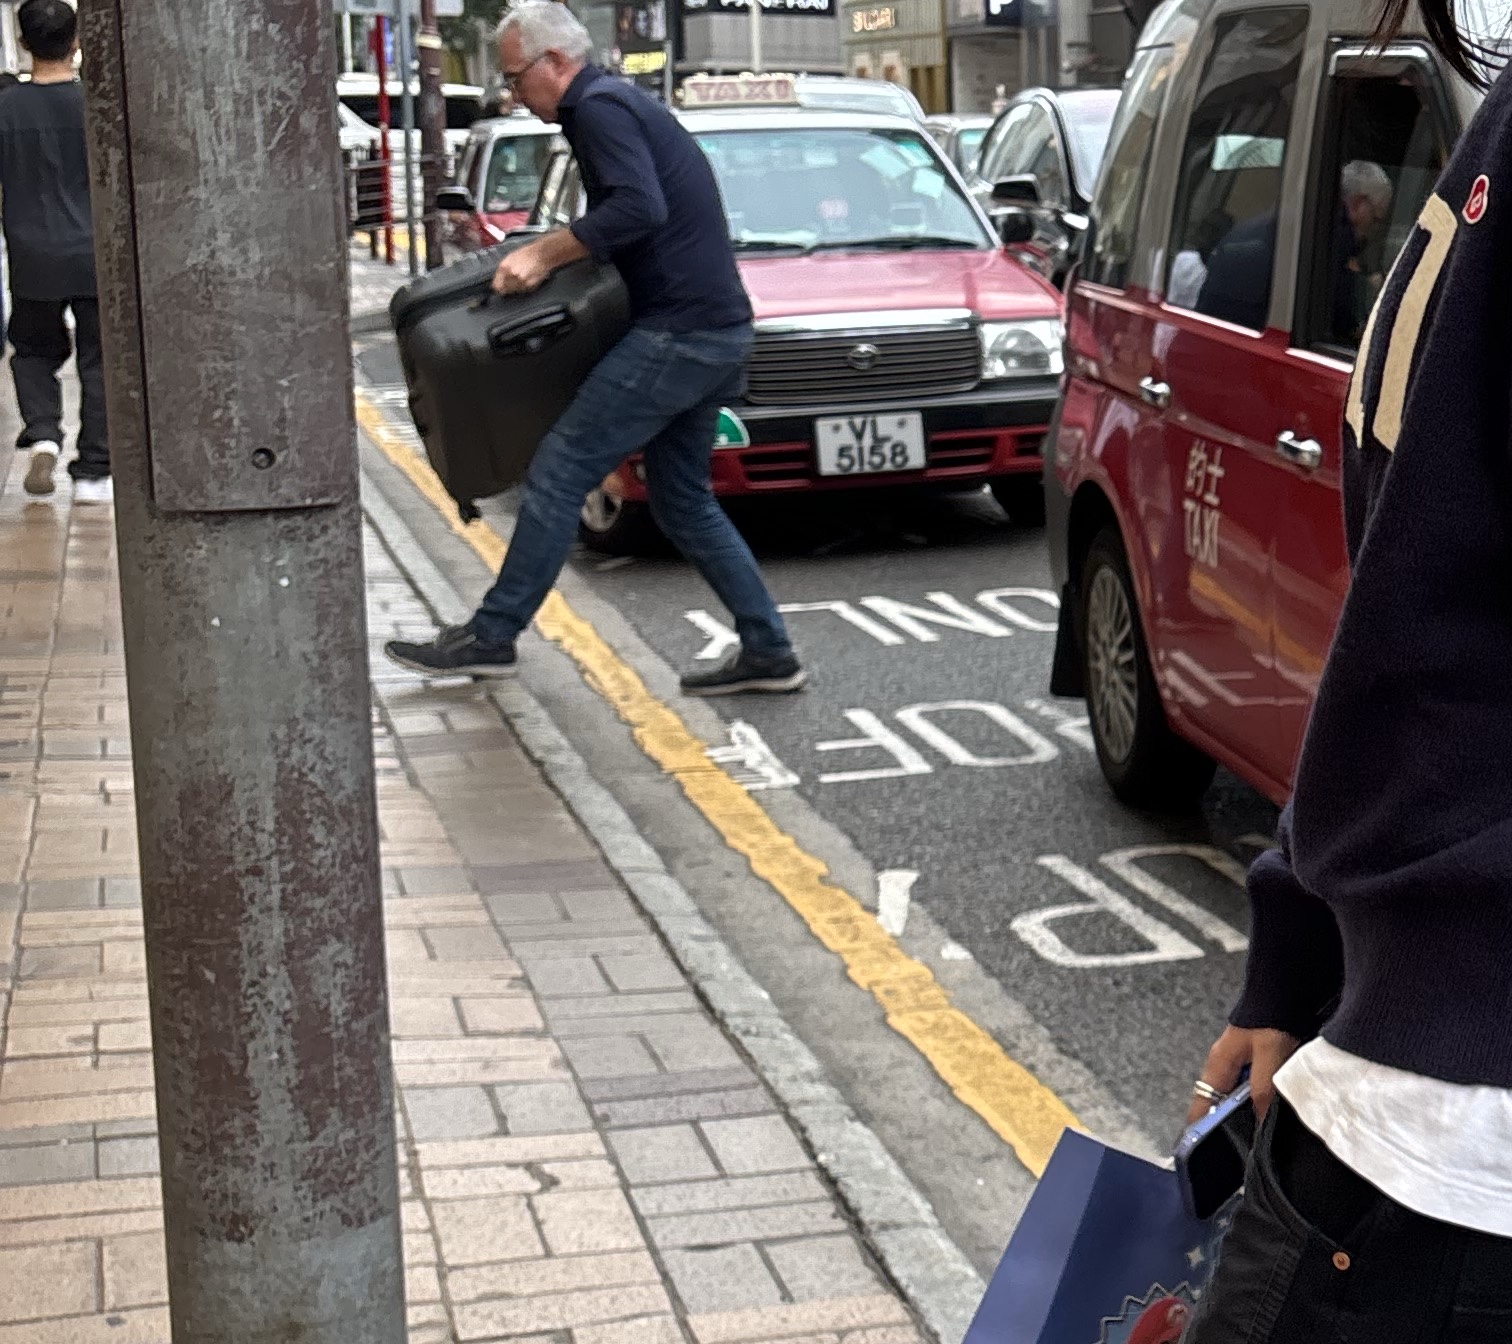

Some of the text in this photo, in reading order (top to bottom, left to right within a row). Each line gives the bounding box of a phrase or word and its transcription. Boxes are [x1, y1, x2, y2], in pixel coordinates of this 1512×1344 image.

[689, 79, 790, 102] TAXI
[836, 440, 909, 473] 5158
[1184, 438, 1225, 506] 的士
